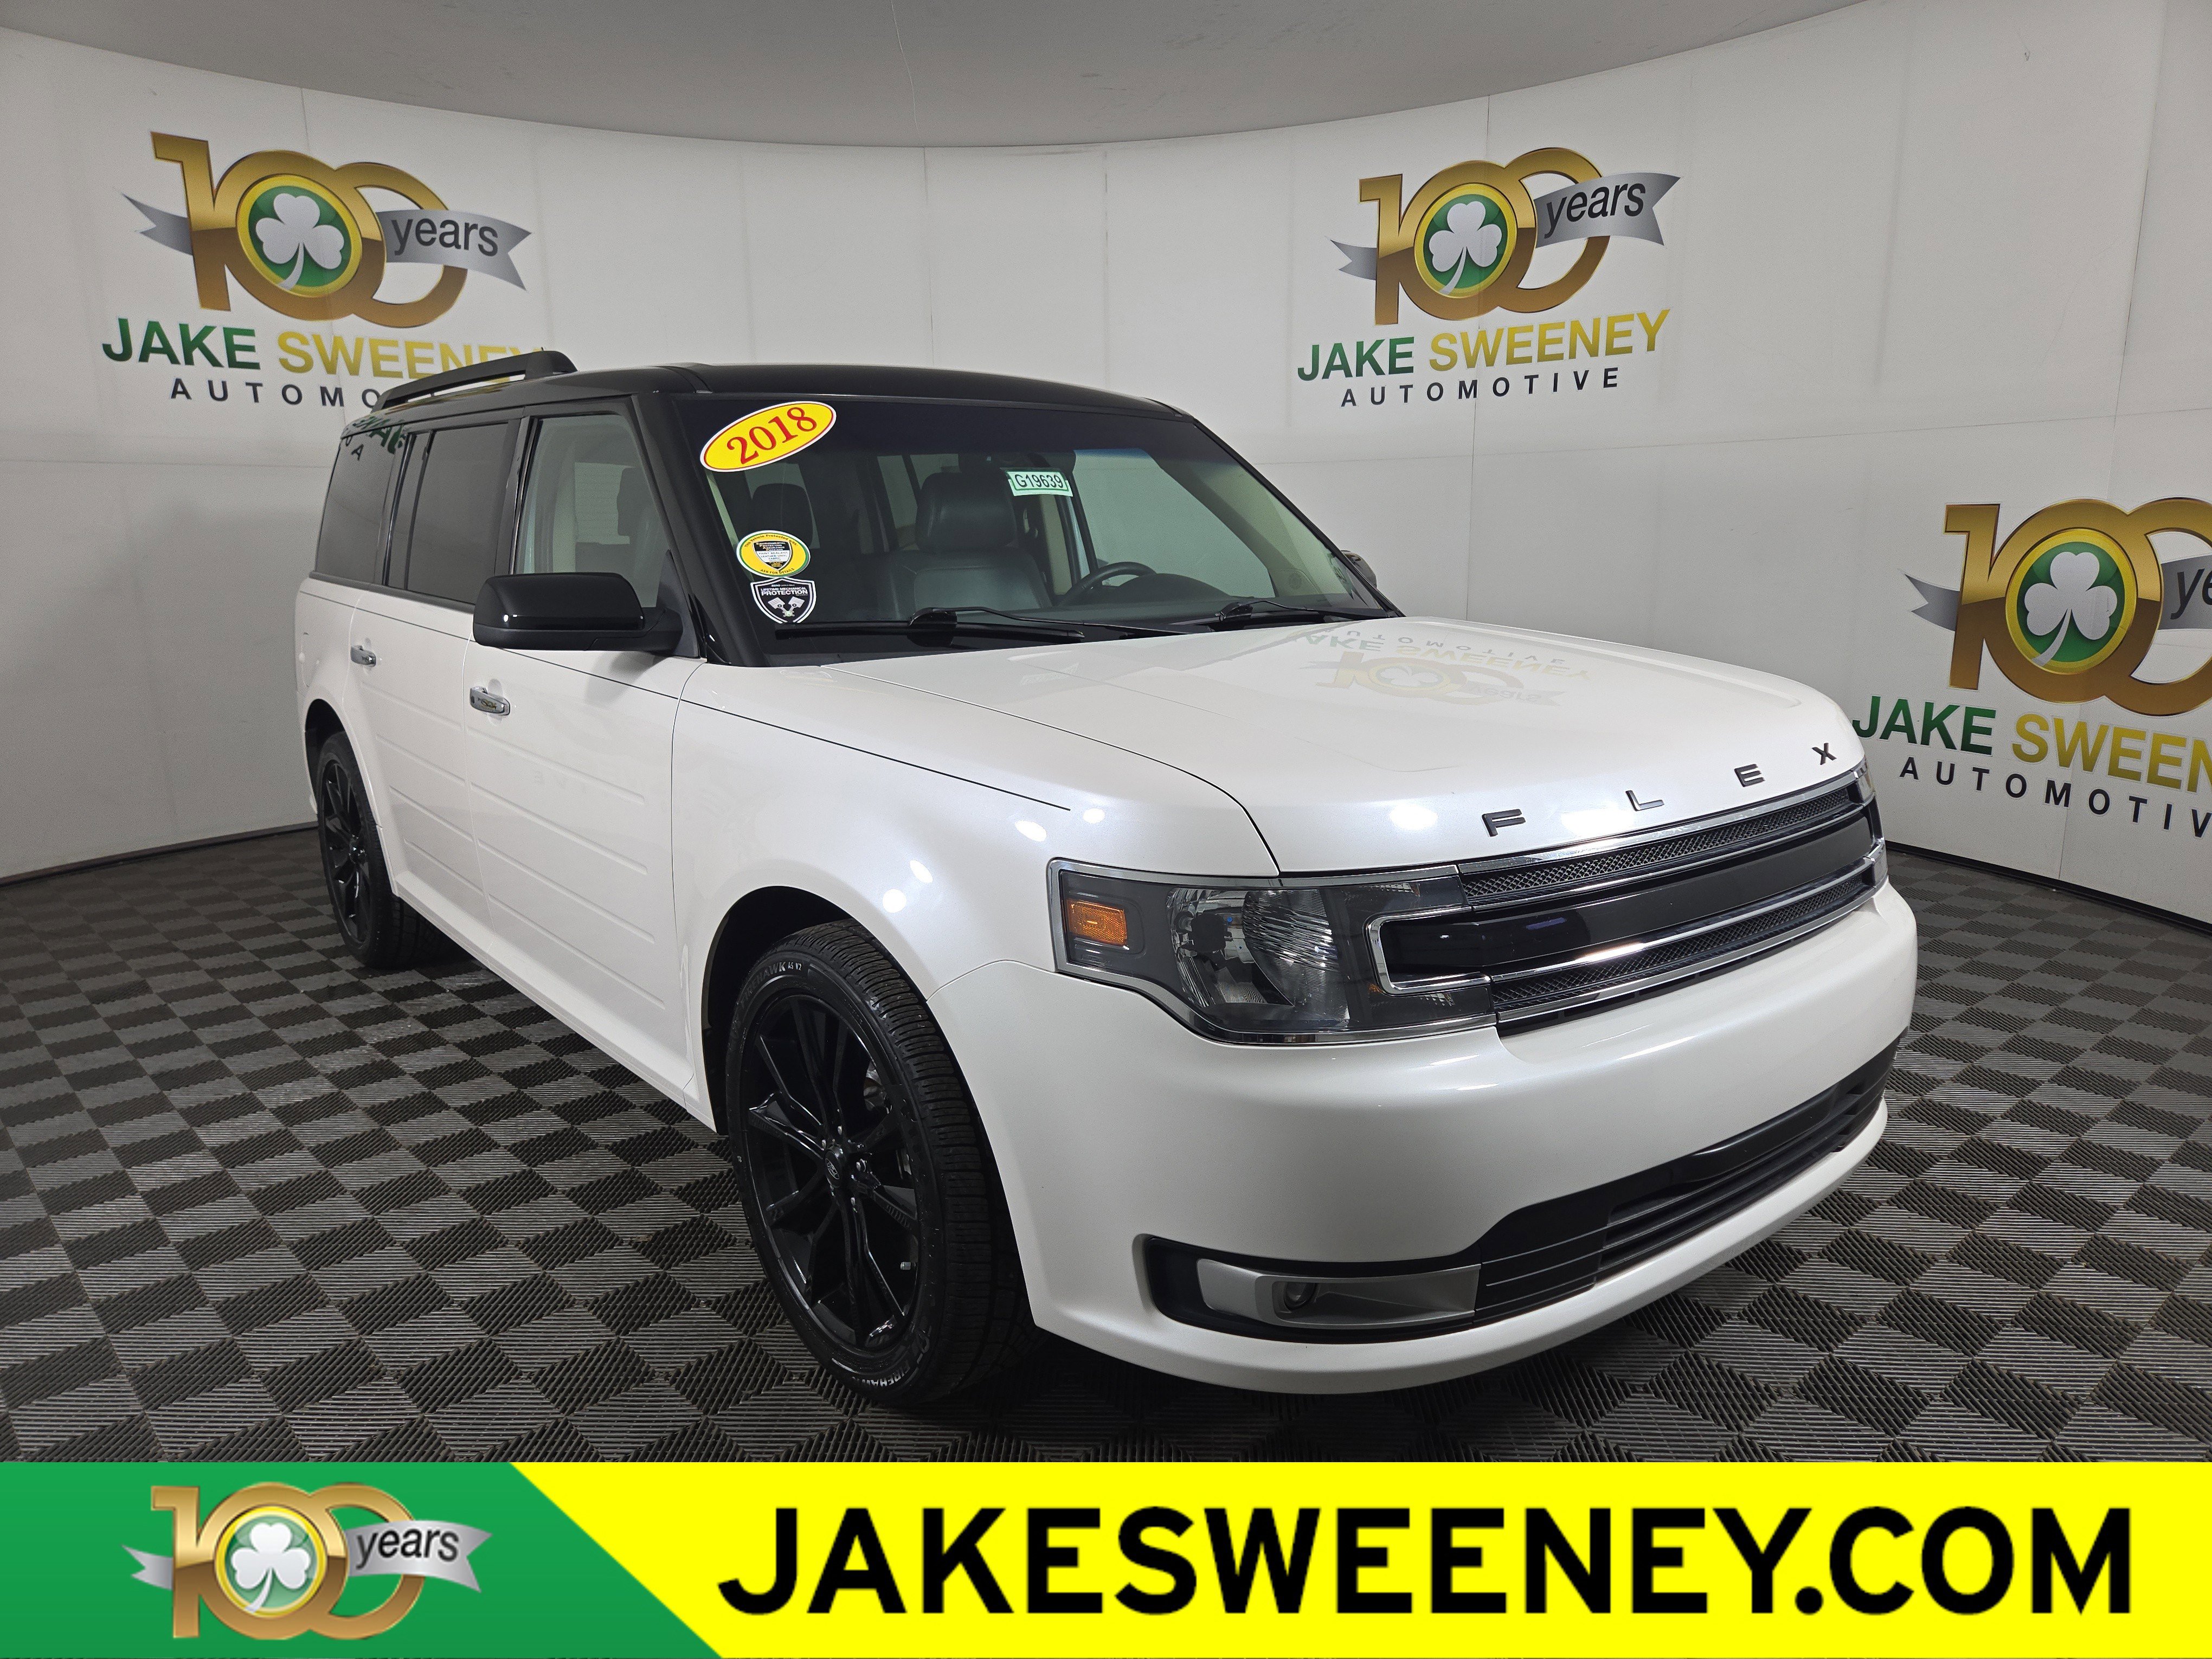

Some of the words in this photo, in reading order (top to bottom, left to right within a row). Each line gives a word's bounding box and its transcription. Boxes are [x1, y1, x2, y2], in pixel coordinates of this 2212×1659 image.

[390, 217, 500, 257] years
[1544, 179, 1647, 239] years
[101, 317, 261, 370] JAKE
[1297, 336, 1415, 381] JAKE
[1429, 308, 1671, 372] SWEENEY
[170, 377, 381, 410] AUTOMO
[1341, 367, 1619, 408] AUTOMOTIVE
[726, 406, 817, 465] 2018
[1014, 474, 1064, 488] G19639
[1852, 696, 1997, 756] JAKE
[2012, 713, 2212, 794] SWEEN
[1481, 742, 1837, 837] FLEX
[1899, 756, 2212, 839] AUTOMOTIV
